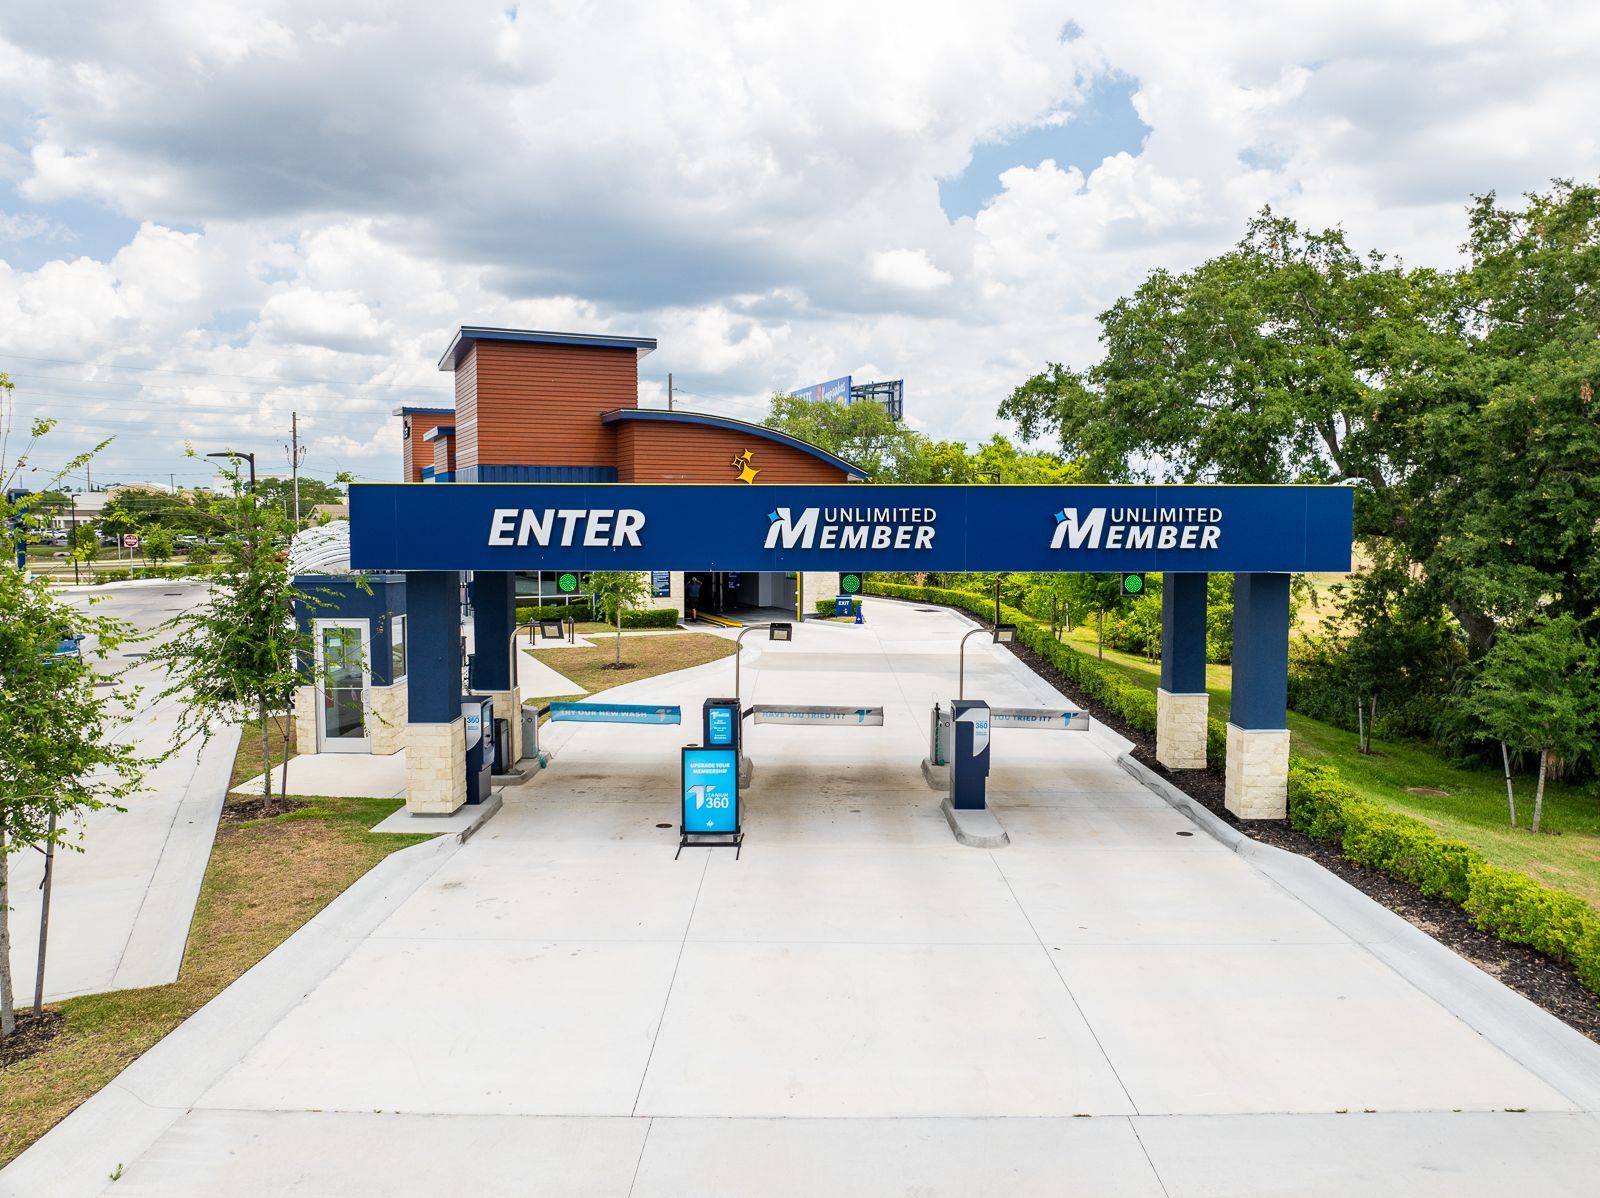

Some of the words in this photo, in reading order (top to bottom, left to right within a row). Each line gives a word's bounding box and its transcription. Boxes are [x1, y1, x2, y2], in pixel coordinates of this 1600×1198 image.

[825, 507, 937, 523] UNLIMITED
[1111, 507, 1223, 523] UNLIMITED
[488, 508, 646, 547] ENTER
[764, 507, 936, 550] MEMBER
[1050, 507, 1222, 550] MEMBER
[787, 711, 804, 719] YOU
[705, 797, 729, 808] 360
